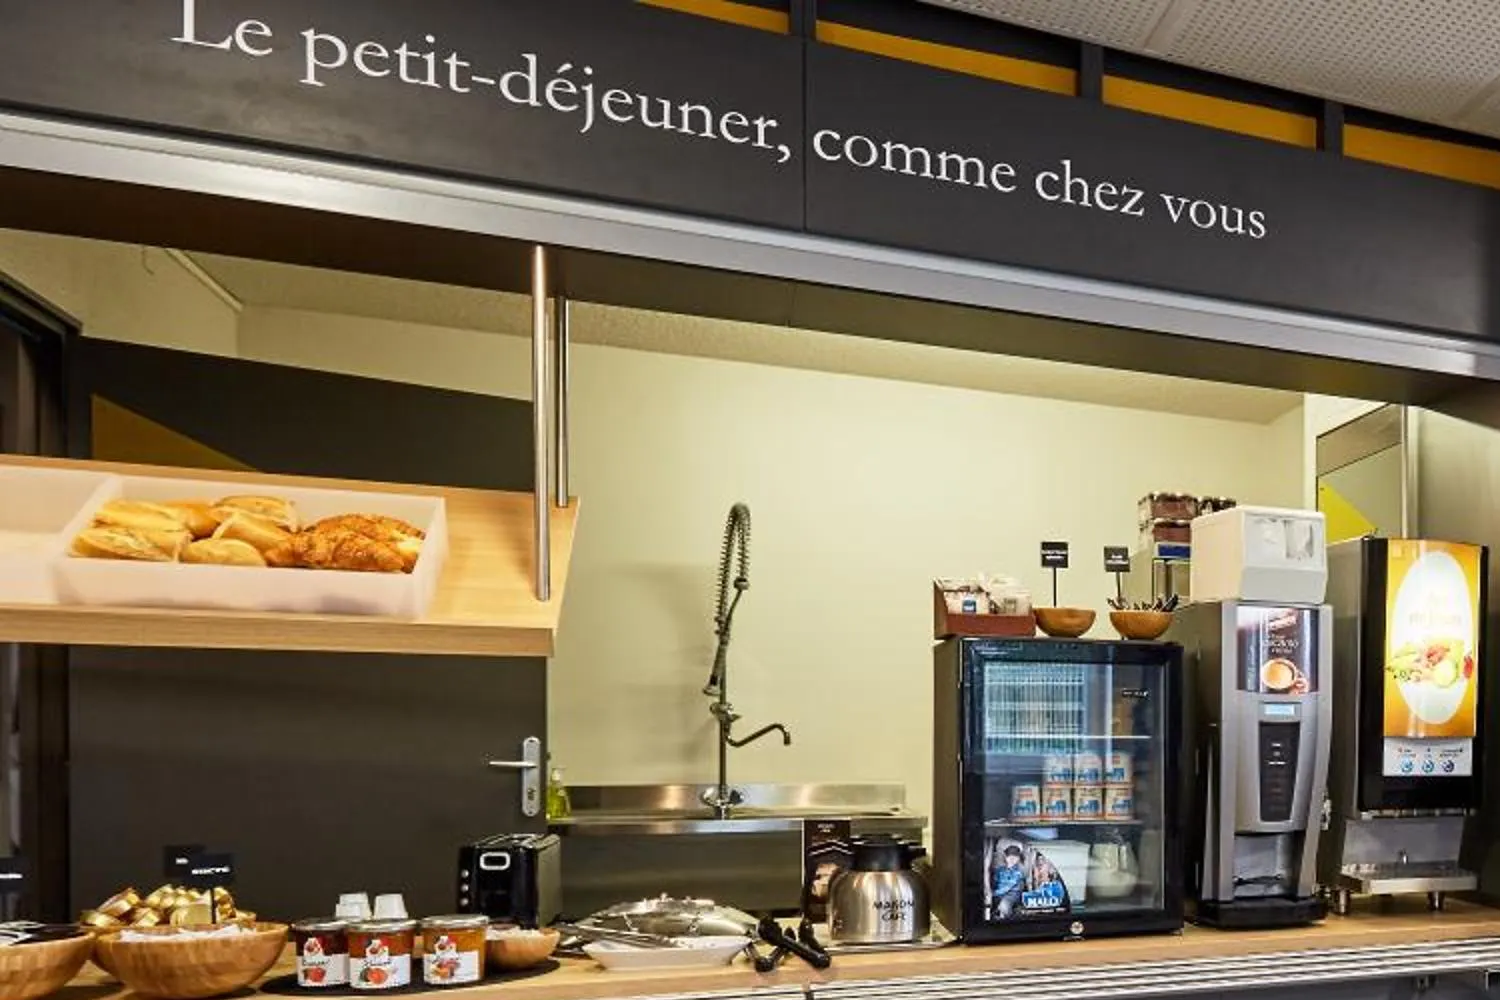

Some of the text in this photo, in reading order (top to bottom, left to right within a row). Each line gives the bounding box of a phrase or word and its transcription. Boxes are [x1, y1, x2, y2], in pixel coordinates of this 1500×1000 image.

[170, 0, 1267, 239] Le petit-déjeuner, comme chez vous
